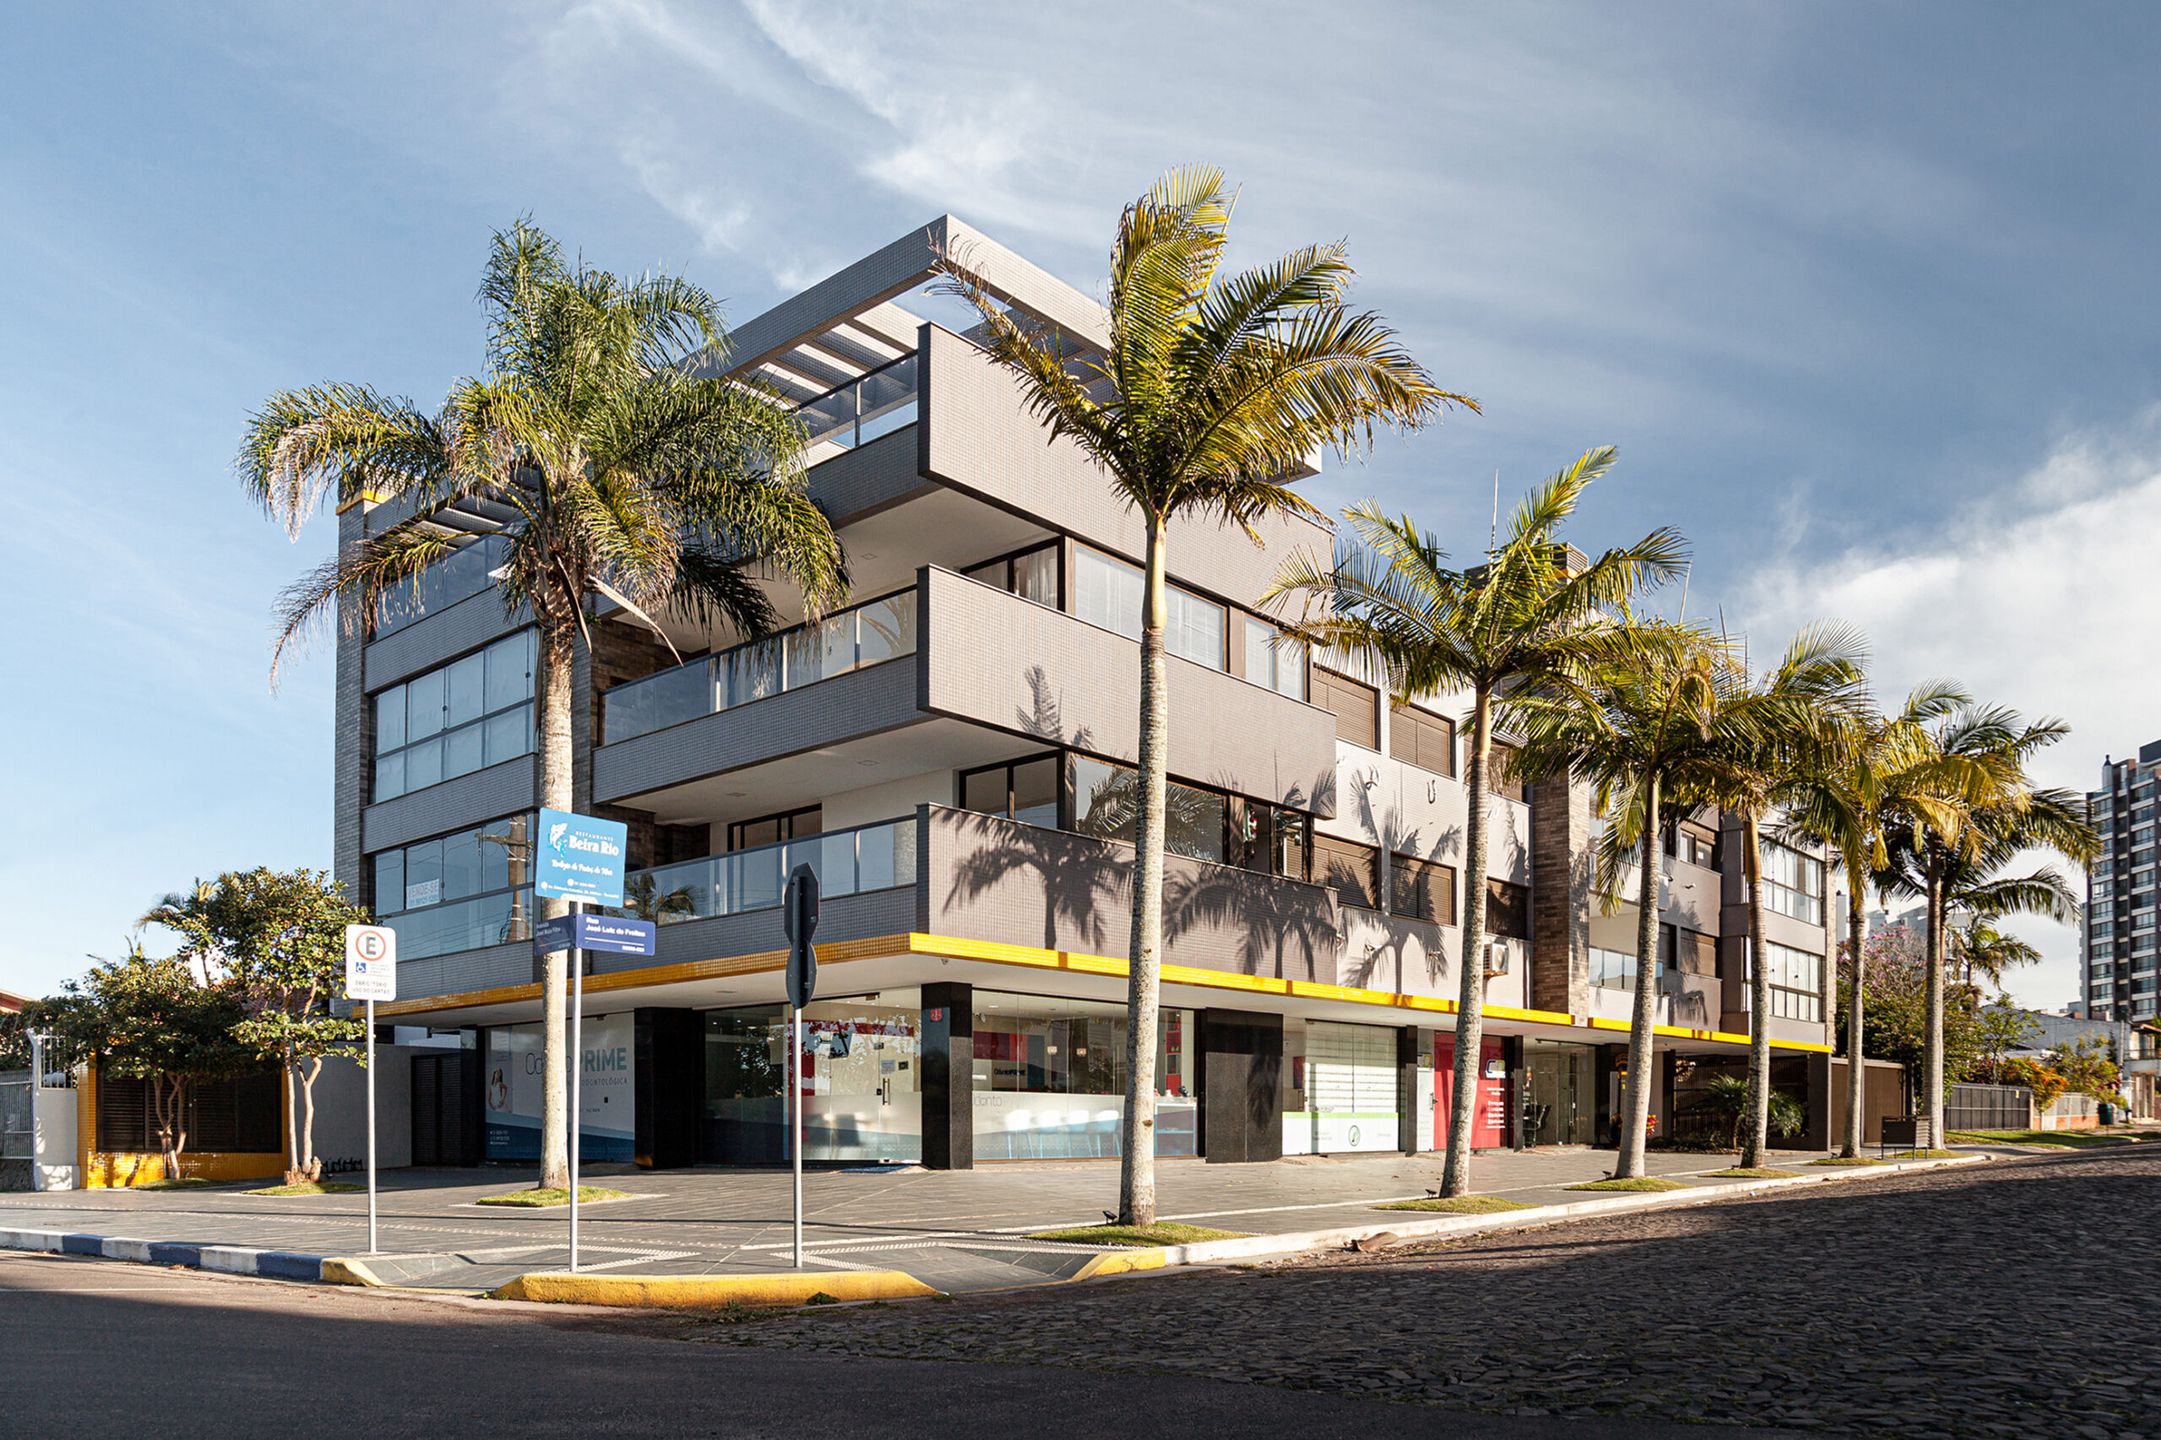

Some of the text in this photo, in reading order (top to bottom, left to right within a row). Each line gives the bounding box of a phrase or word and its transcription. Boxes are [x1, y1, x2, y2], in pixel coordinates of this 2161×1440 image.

[569, 835, 620, 856] Beira Rio
[366, 936, 377, 955] E
[580, 1047, 627, 1072] RIME
